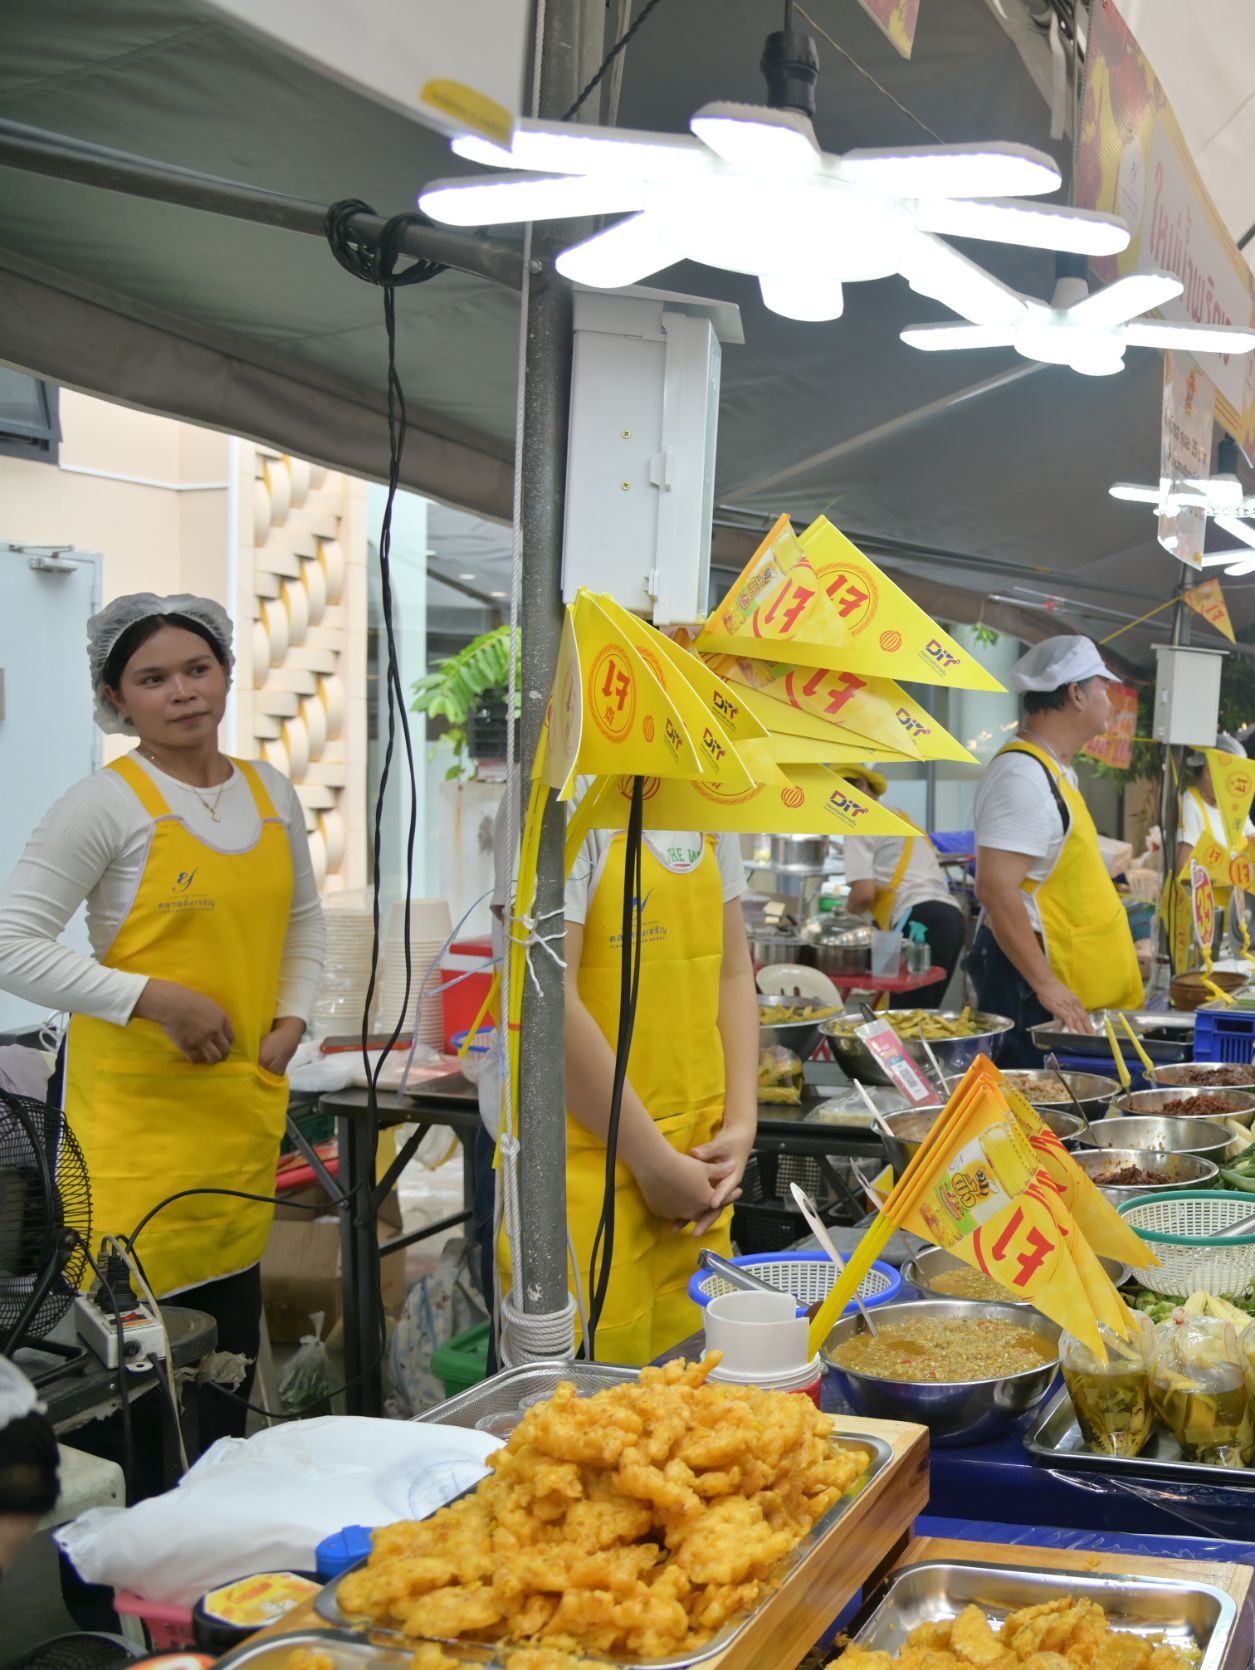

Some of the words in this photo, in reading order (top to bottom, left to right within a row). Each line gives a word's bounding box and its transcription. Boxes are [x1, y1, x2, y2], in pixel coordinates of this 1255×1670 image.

[764, 577, 816, 634] เจ
[826, 574, 869, 618] เจ
[602, 659, 630, 712] เจ
[991, 1205, 1056, 1288] เจ
